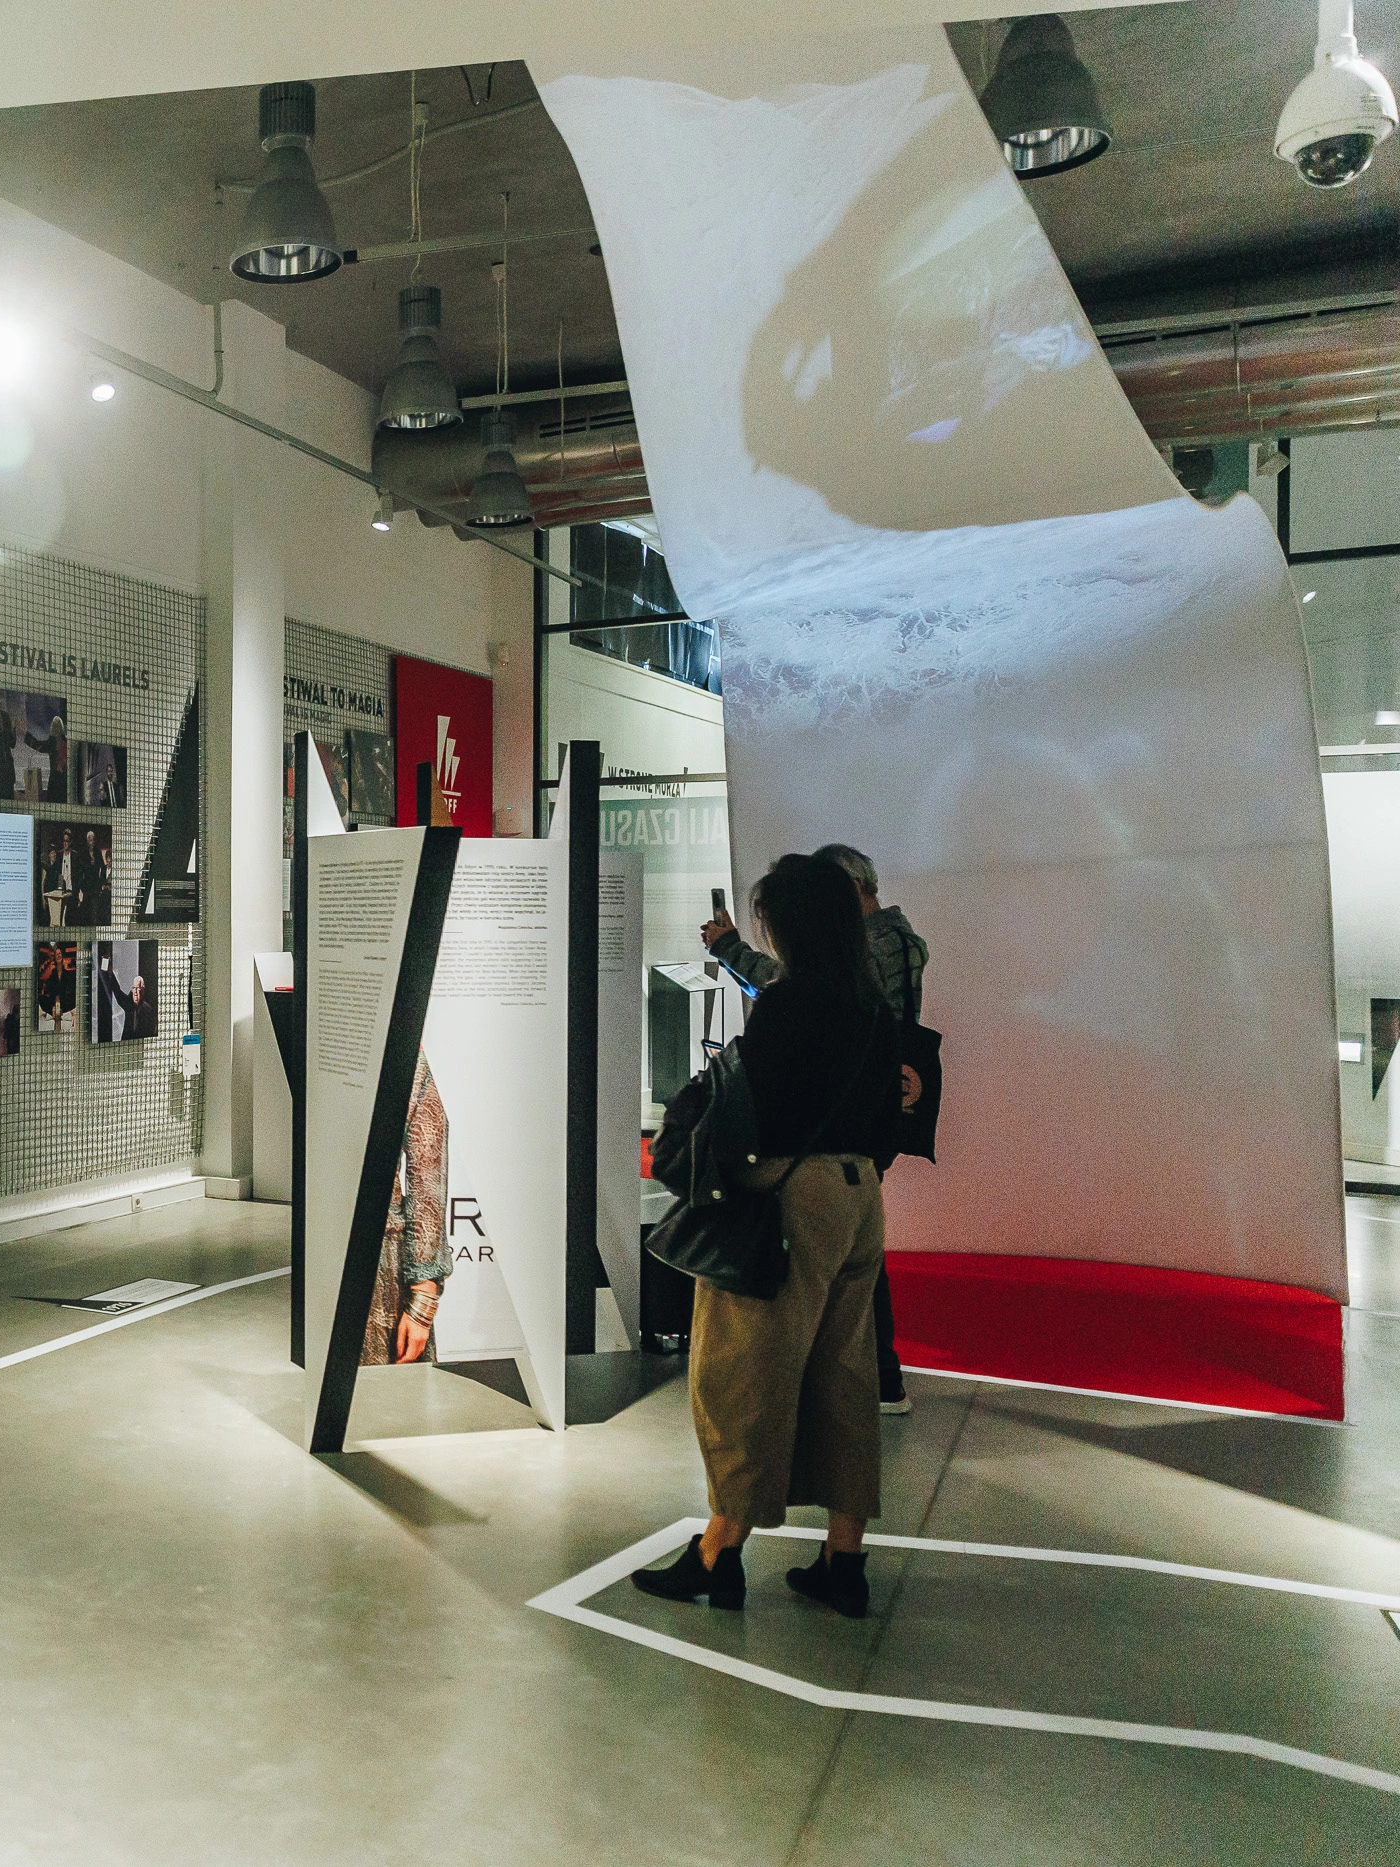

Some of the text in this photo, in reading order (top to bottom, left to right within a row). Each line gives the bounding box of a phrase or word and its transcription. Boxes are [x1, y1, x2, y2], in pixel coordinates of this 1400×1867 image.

[62, 653, 77, 677] IS
[81, 658, 149, 690] LAURELS
[283, 676, 384, 717] STIWAL TO MAGIA
[450, 1197, 485, 1236] R
